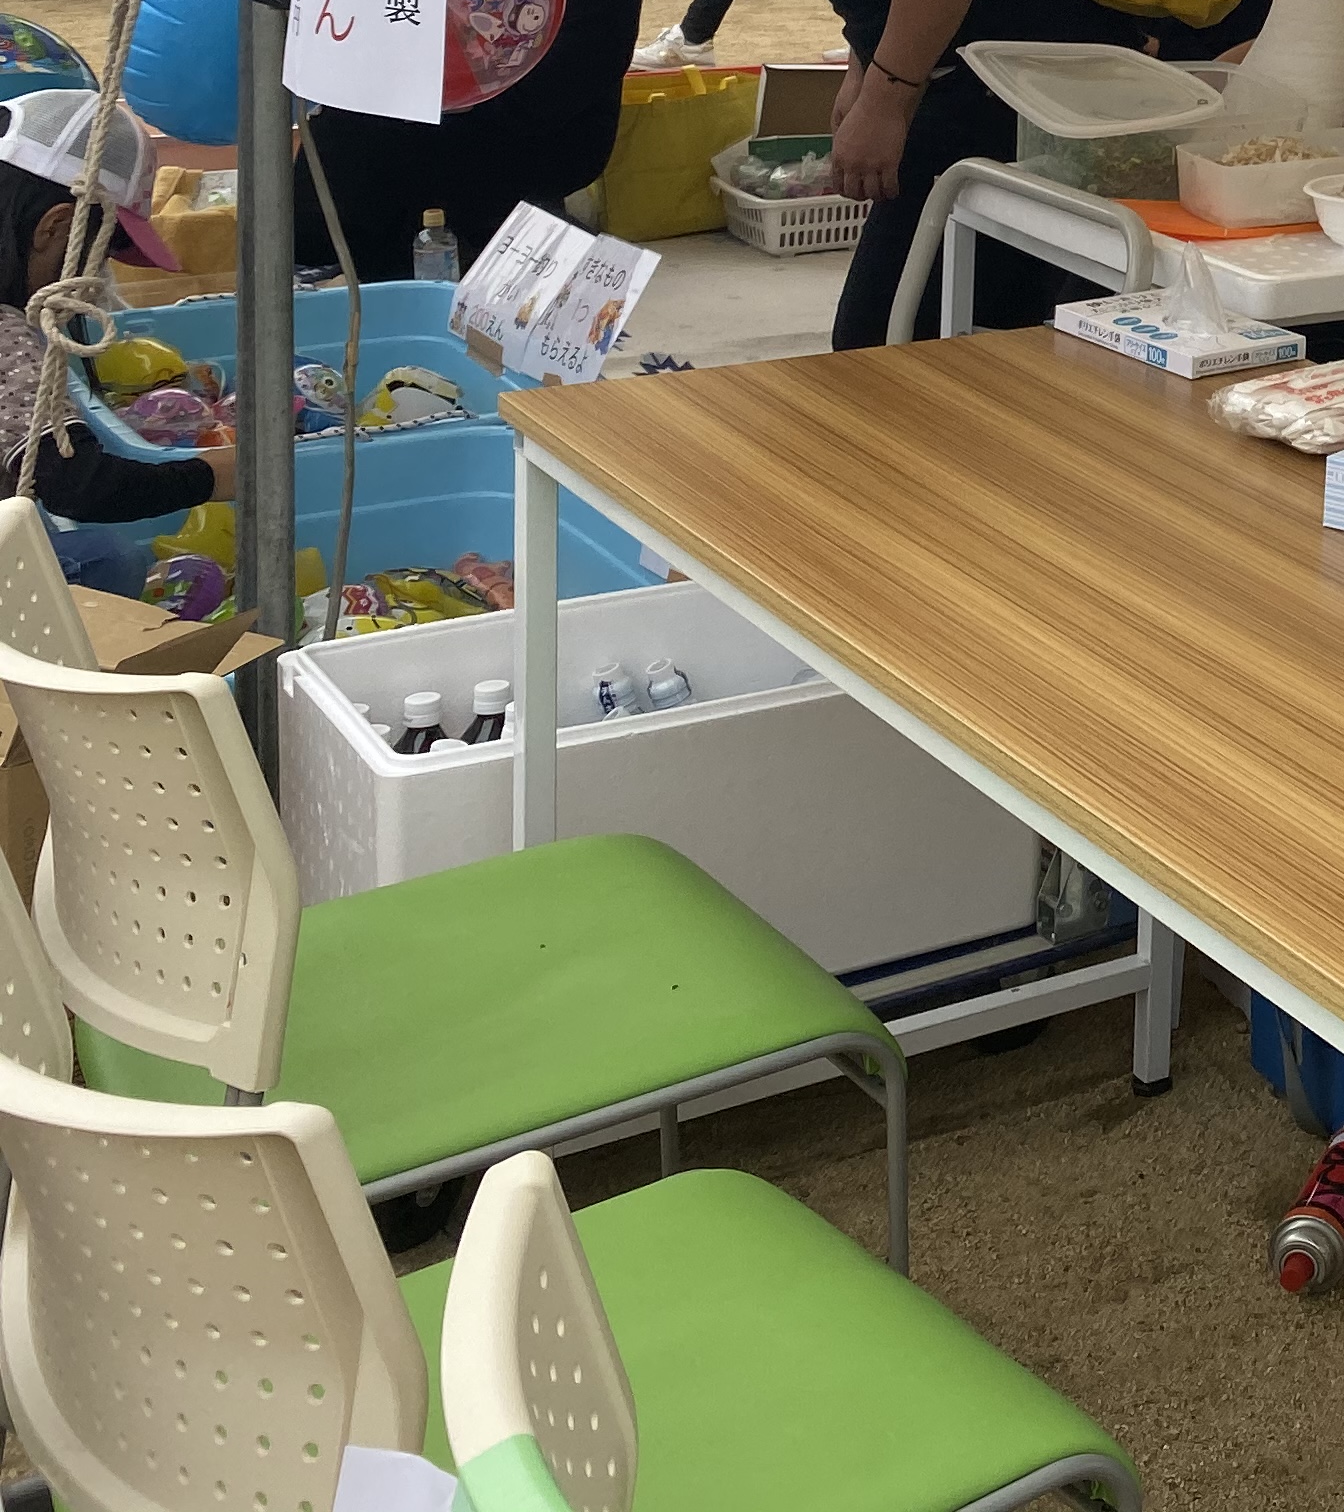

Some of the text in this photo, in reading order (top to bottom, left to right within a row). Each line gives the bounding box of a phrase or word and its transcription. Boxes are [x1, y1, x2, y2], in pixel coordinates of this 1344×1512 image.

[582, 256, 628, 291] すきなもの
[539, 333, 589, 375] もらえるよ
